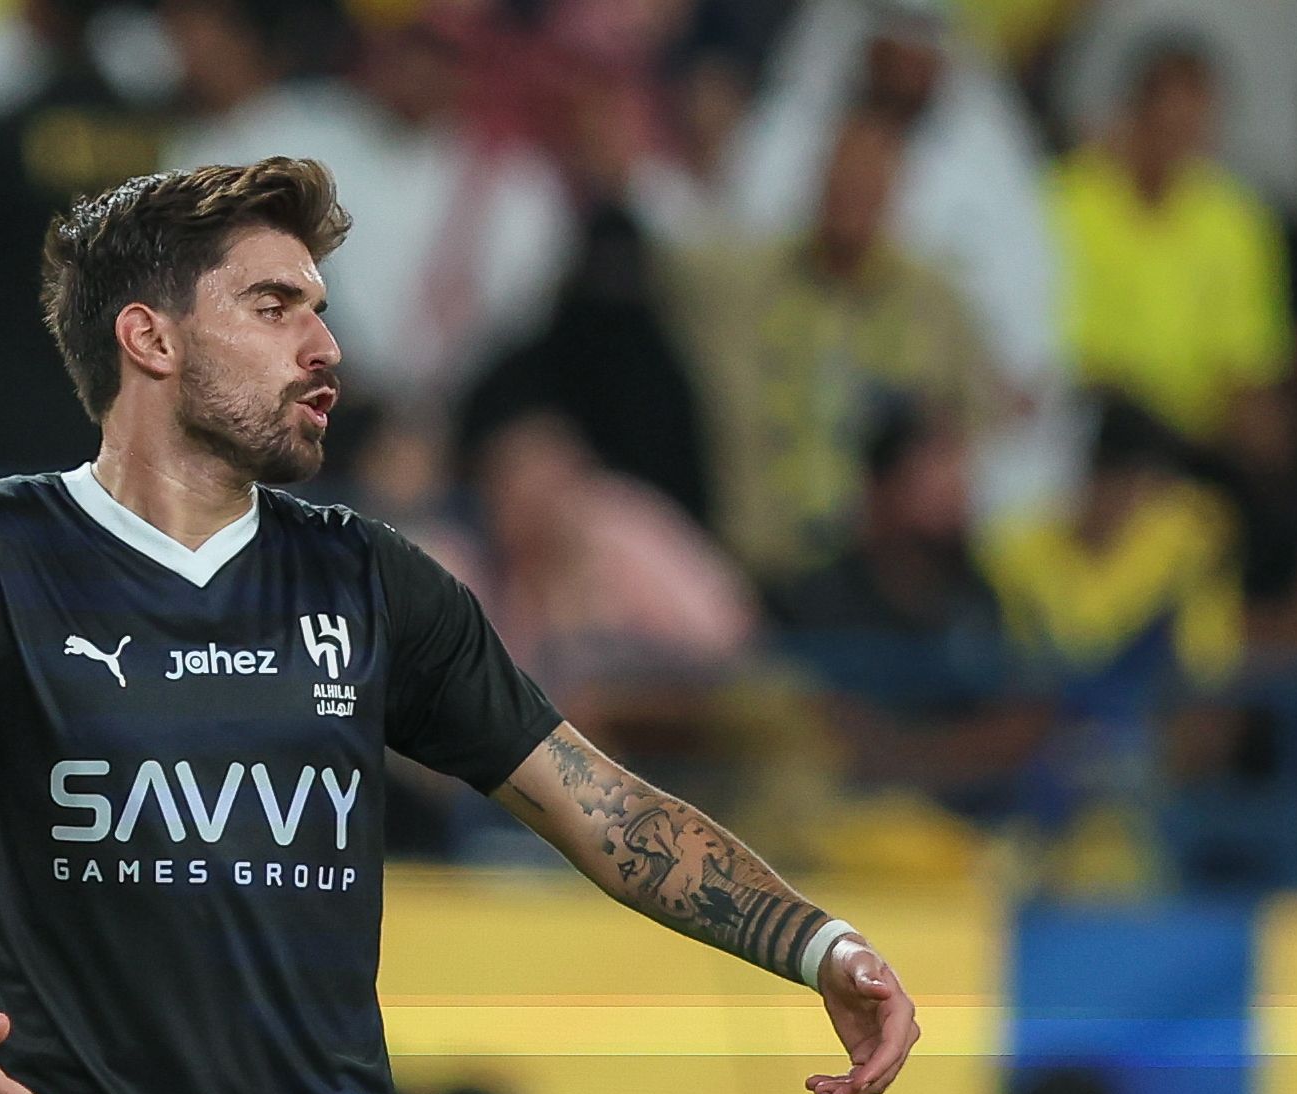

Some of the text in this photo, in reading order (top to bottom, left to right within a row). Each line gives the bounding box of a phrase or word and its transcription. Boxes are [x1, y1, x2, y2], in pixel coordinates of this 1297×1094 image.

[50, 759, 361, 850] SAVVY
[53, 858, 357, 892] GAMES GROUP
